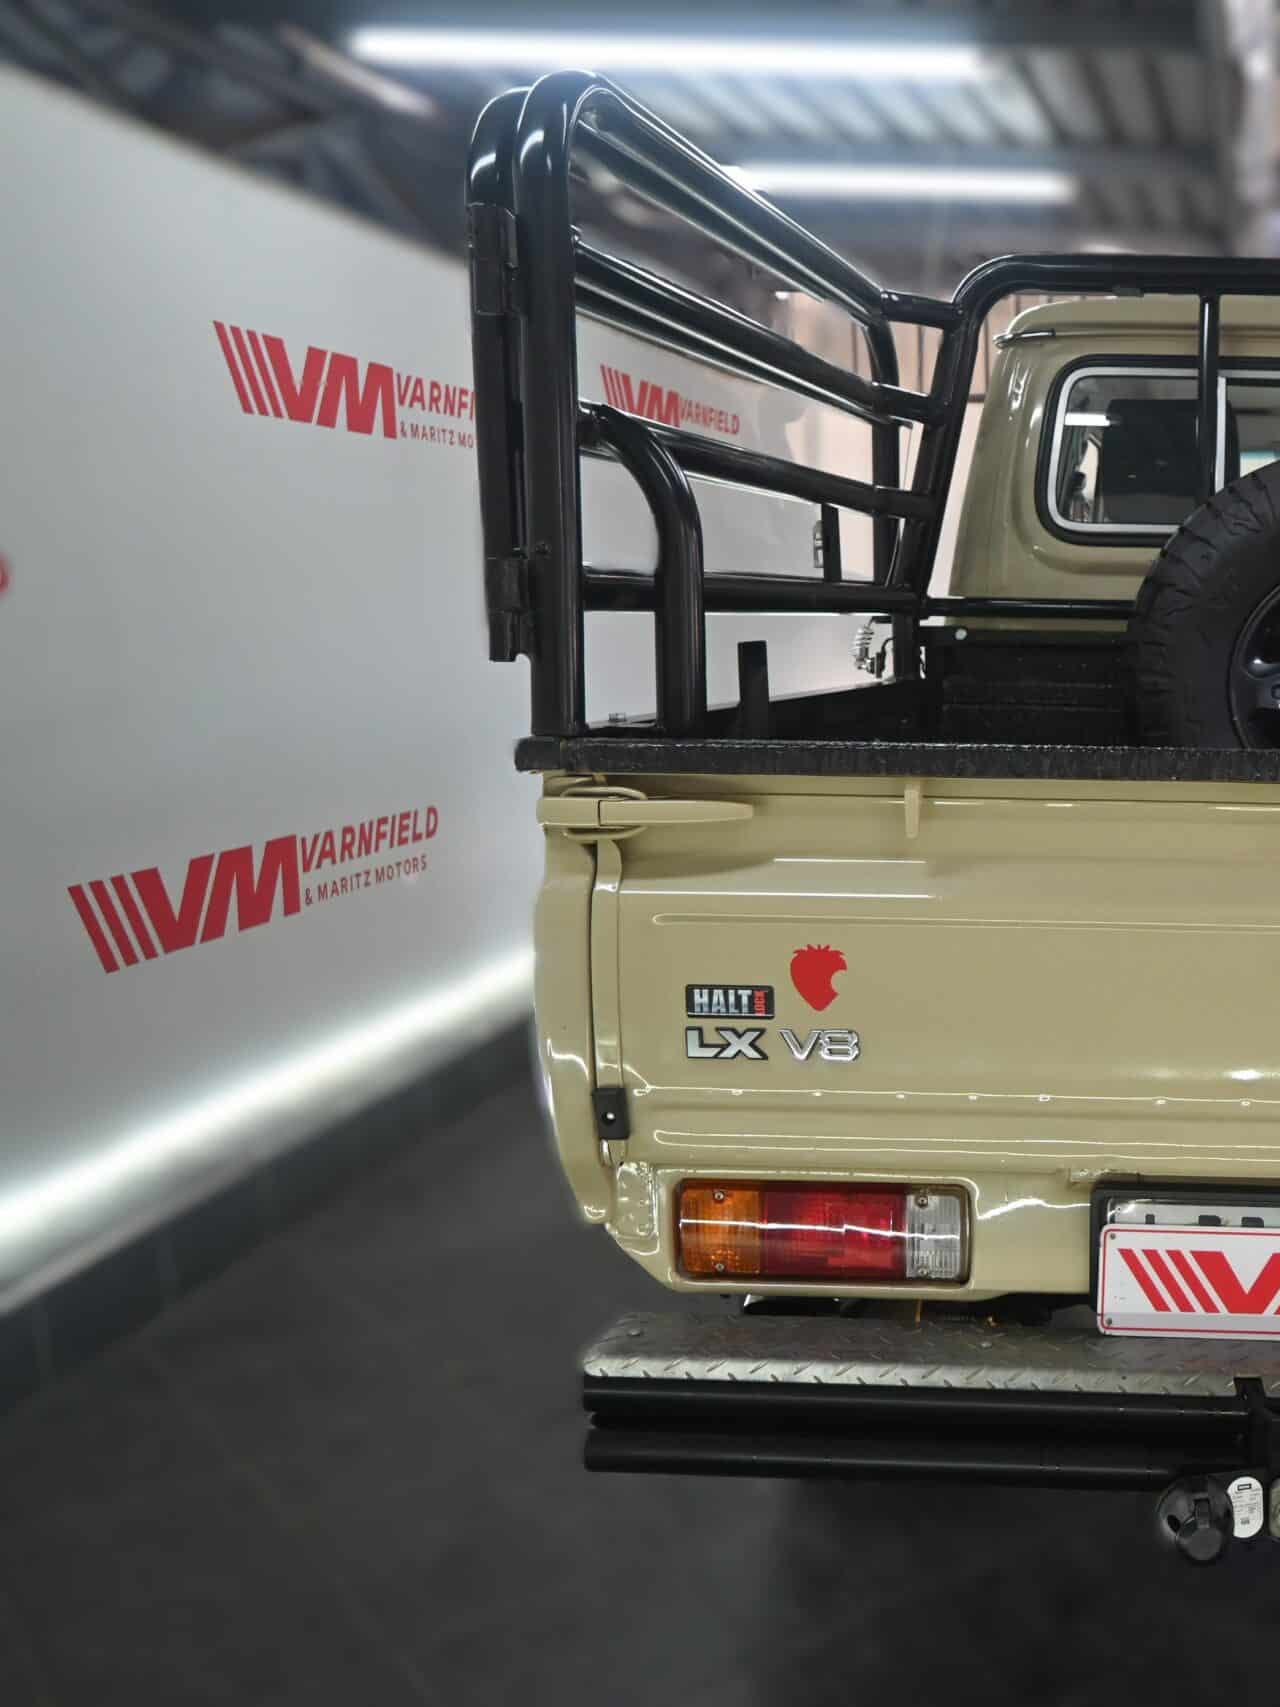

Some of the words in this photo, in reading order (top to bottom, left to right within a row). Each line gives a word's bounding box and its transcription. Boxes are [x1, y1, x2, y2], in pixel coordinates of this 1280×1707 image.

[262, 334, 397, 440] VM
[397, 372, 476, 421] VARNFI
[410, 423, 455, 446] MARITZ
[680, 398, 740, 434] VARNFIELD
[301, 805, 438, 873] VARNFIELD
[131, 834, 301, 955] VM
[304, 887, 313, 906] &
[317, 869, 371, 902] MARITZ
[375, 854, 427, 884] MOTORS
[694, 989, 752, 1014] HALT
[685, 1026, 768, 1060] LX
[779, 1028, 860, 1061] V8
